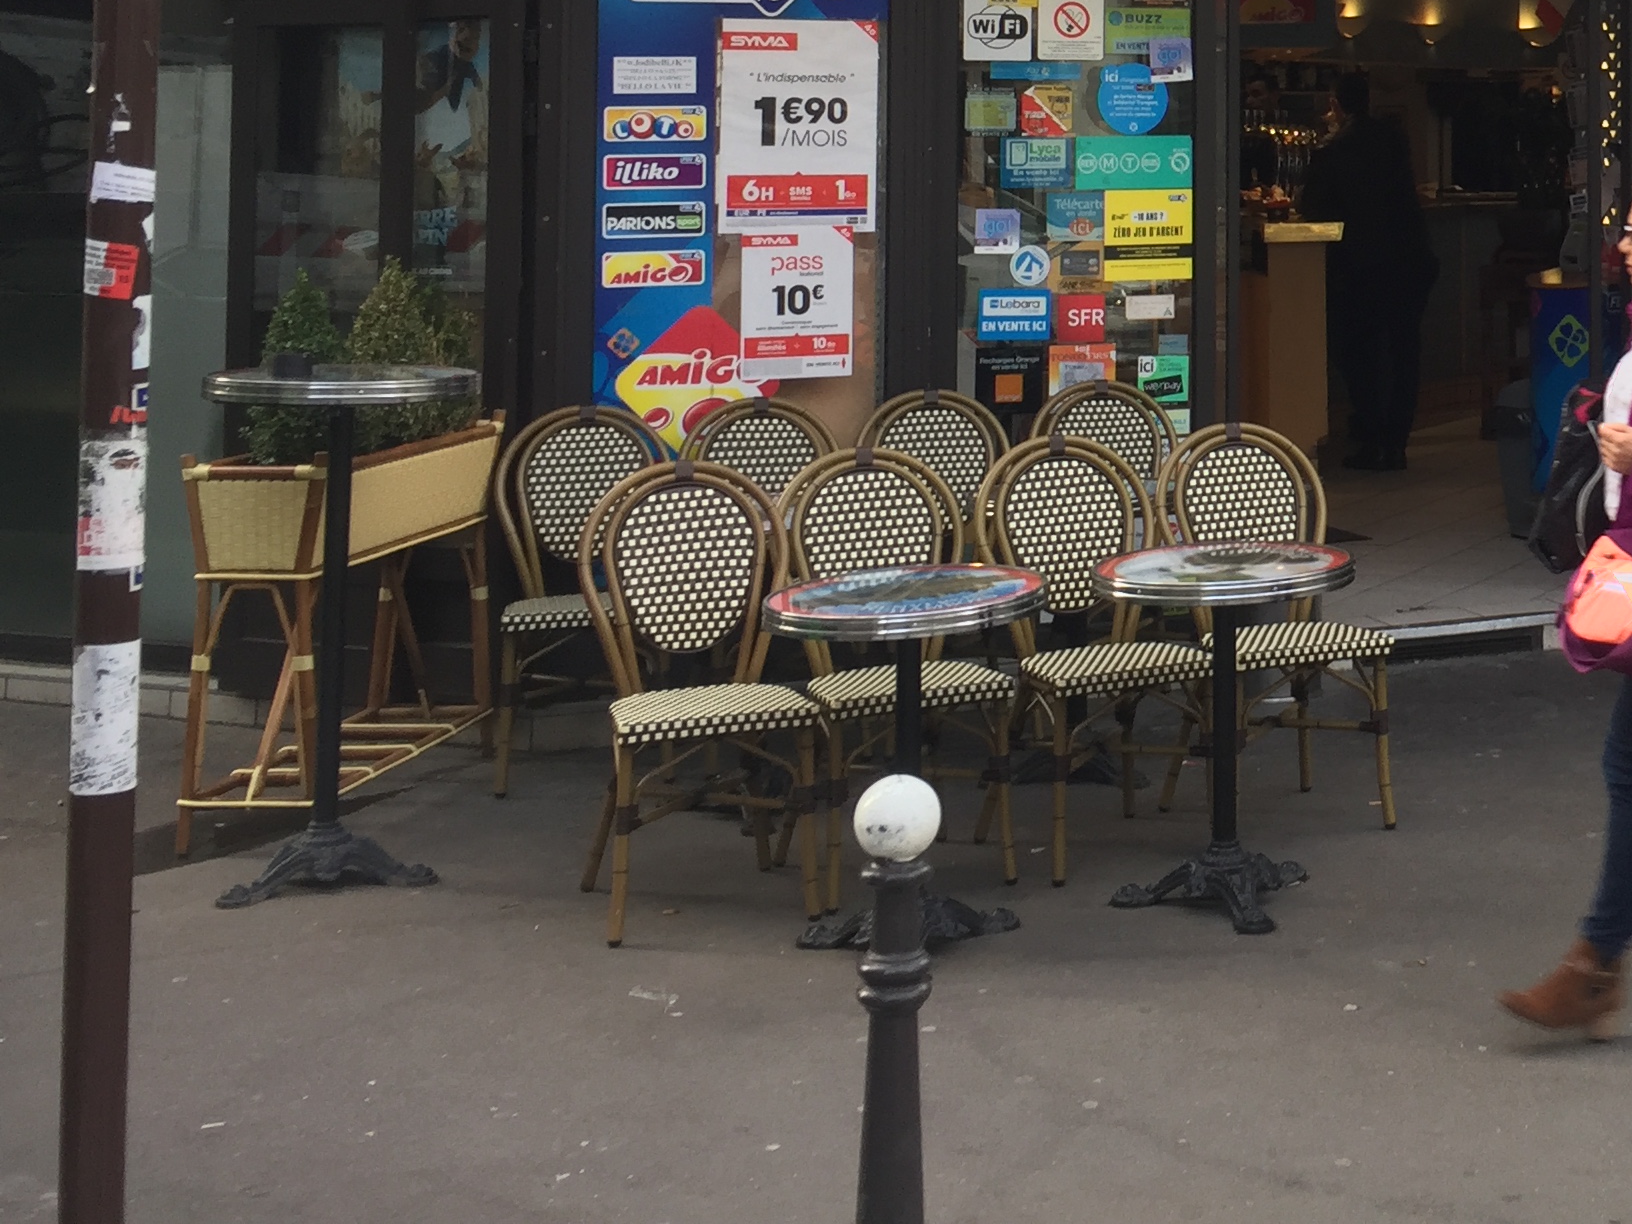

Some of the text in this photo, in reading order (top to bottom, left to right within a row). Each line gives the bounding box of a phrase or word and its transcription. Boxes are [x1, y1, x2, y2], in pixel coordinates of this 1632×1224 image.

[1125, 14, 1163, 24] BUZZ
[730, 35, 790, 48] SYMA
[756, 72, 847, 85] L'indispensable
[1105, 69, 1119, 82] ici
[613, 111, 694, 140] LOTO
[781, 127, 848, 148] /MOIS
[1029, 142, 1061, 156] Lyca
[1103, 157, 1115, 169] M
[1124, 157, 1135, 169] T
[614, 160, 680, 185] illiko
[742, 178, 775, 202] 6H
[788, 186, 813, 197] SMS
[606, 216, 676, 232] PARIONS
[1146, 212, 1158, 221] ANS
[1073, 219, 1090, 235] ici
[1134, 226, 1147, 238] JEU
[1149, 225, 1184, 237] D'ARGENT
[750, 236, 792, 246] SYMA
[770, 255, 824, 276] pass
[771, 284, 825, 316] 10€
[1000, 299, 1040, 310] Lebara
[1067, 309, 1105, 327] SFR
[981, 320, 1047, 332] EN VENTE ICI
[636, 348, 742, 387] AMiG
[1139, 358, 1154, 374] ici
